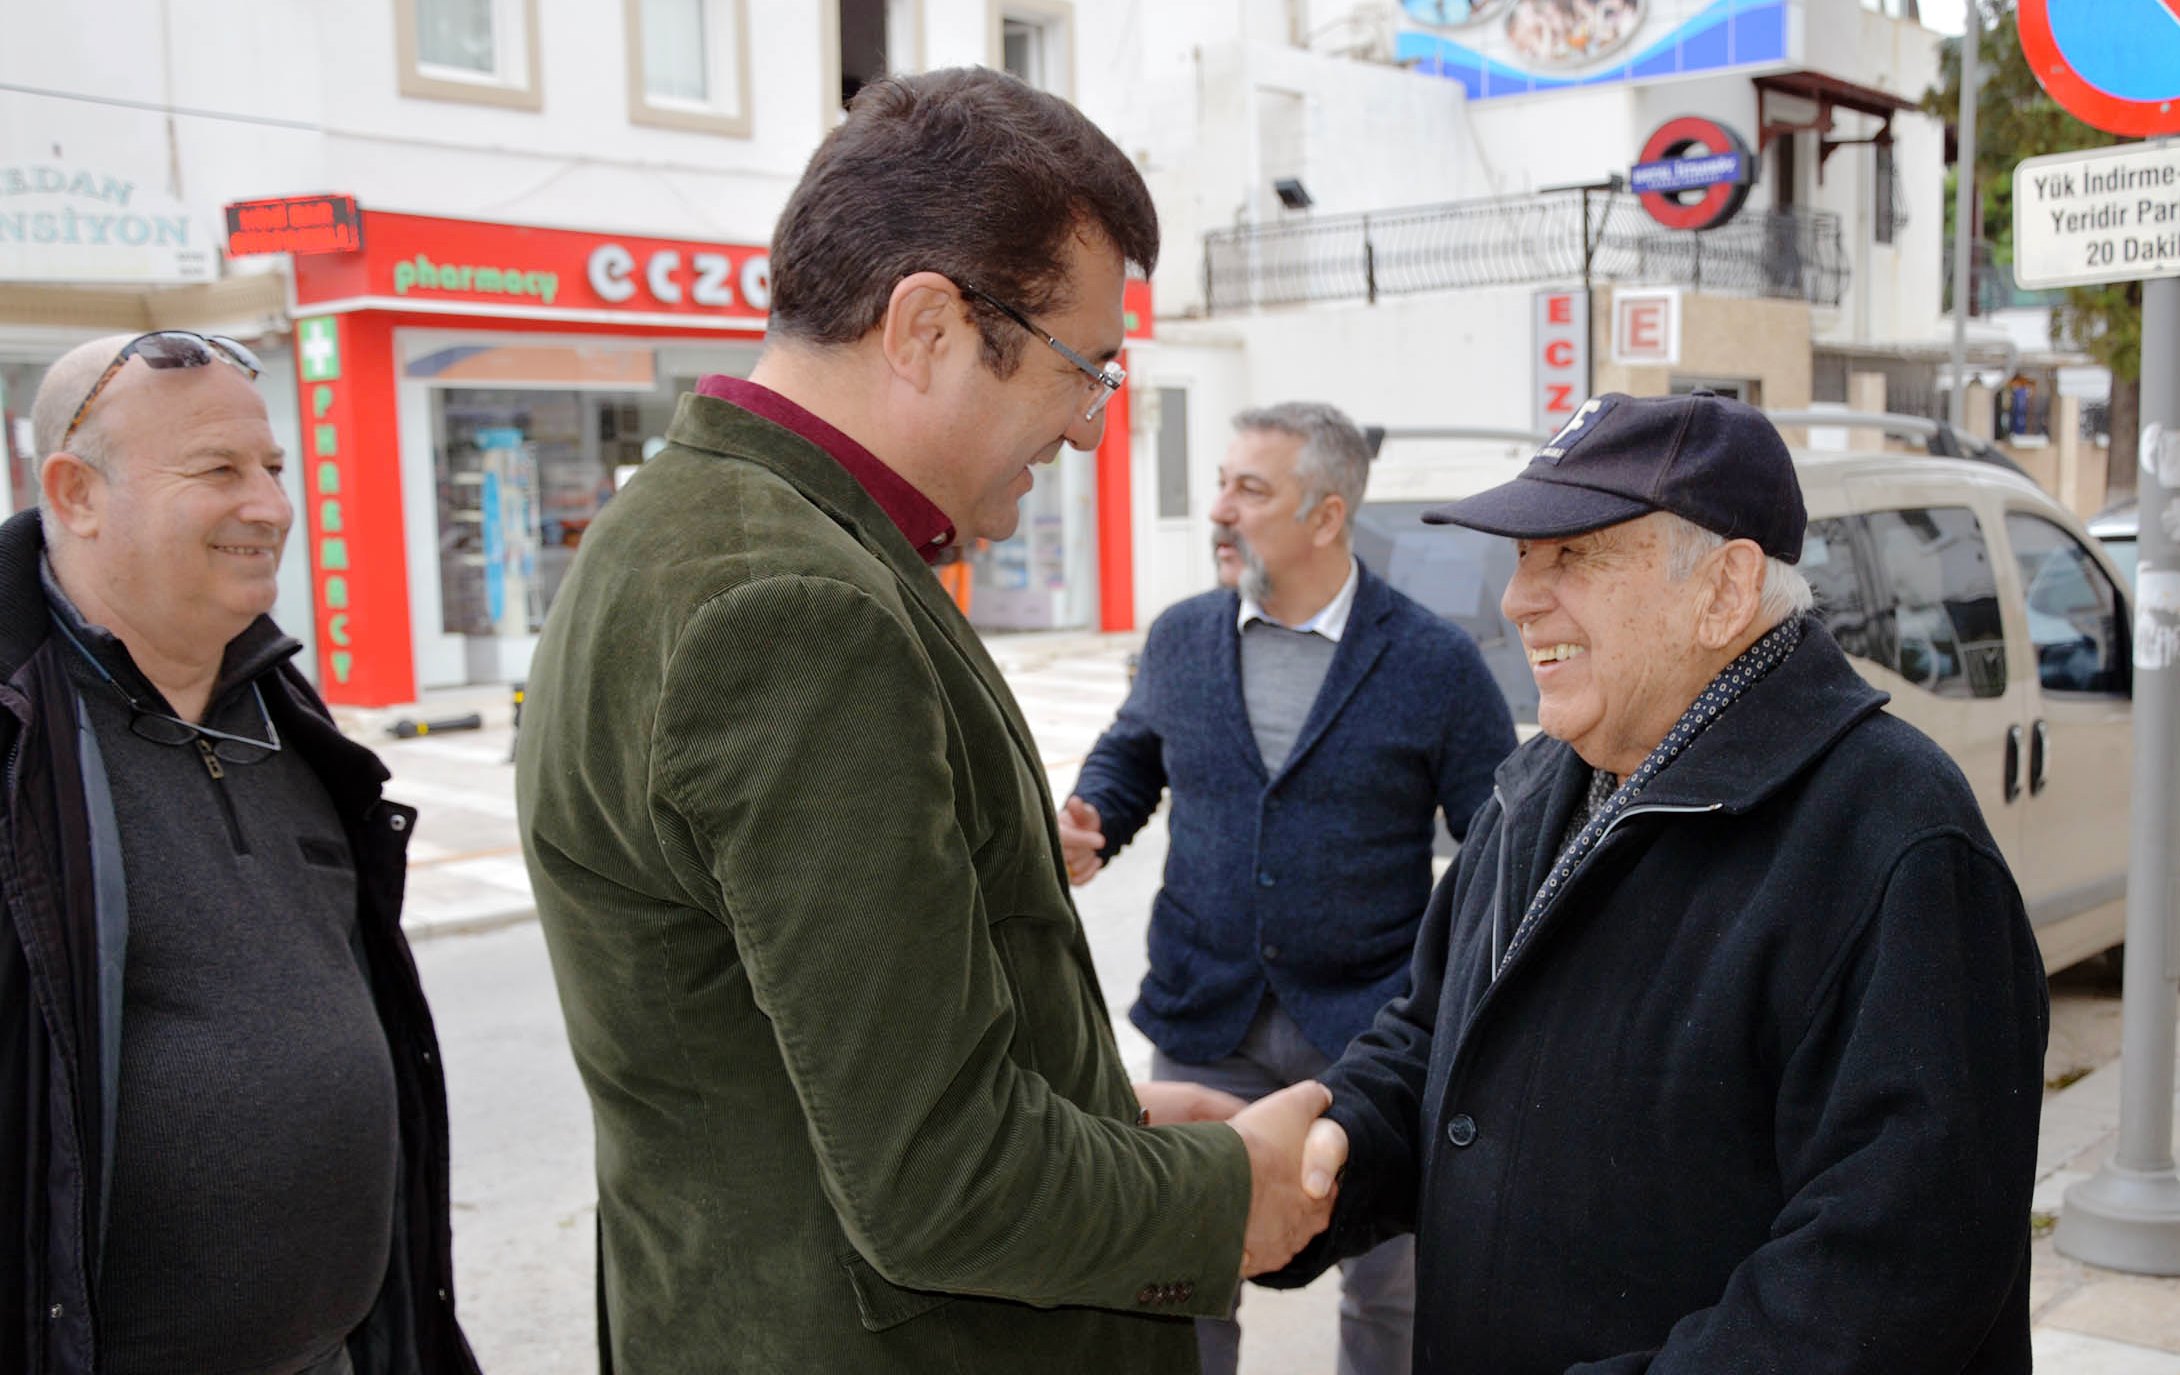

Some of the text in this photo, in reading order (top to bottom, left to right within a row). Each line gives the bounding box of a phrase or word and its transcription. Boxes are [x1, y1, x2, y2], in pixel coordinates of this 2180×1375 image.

[2035, 174, 2074, 200] Yük
[2052, 199, 2180, 235] Yeridir Par
[2087, 233, 2180, 267] 20 Daki
[394, 254, 558, 304] pharmacy
[1545, 295, 1575, 434] ECZ
[313, 385, 352, 684] PHARMACY
